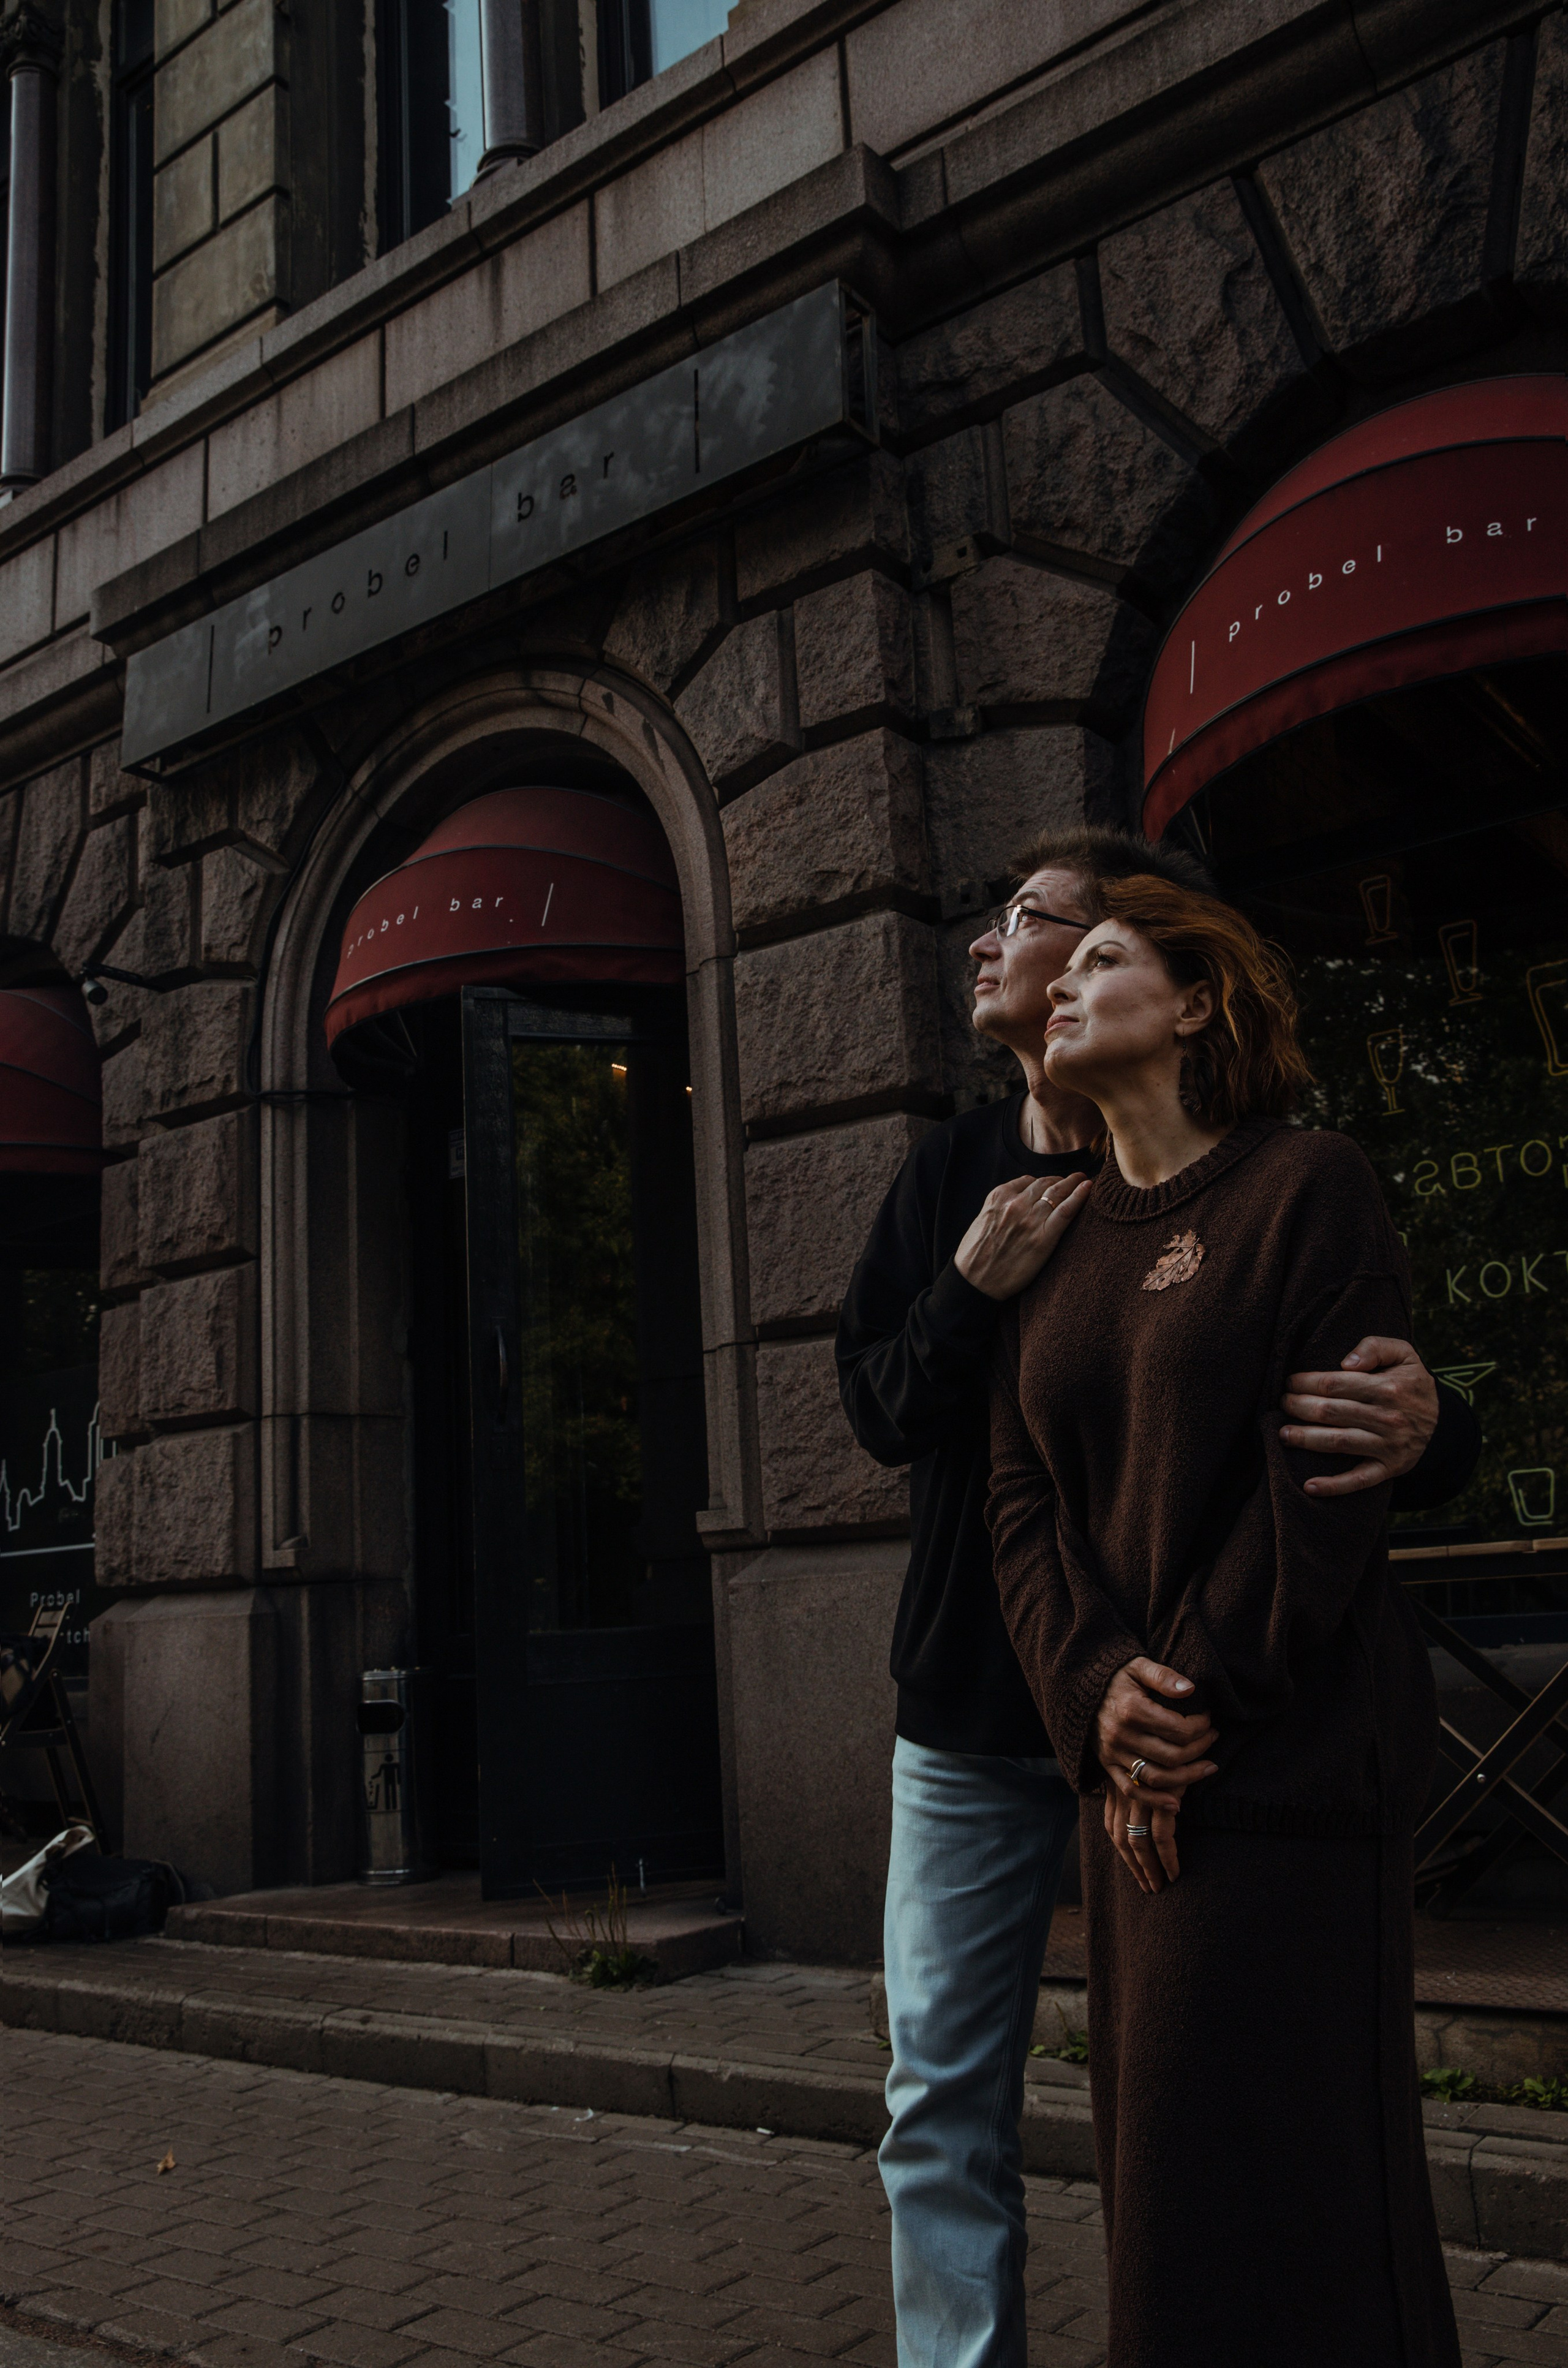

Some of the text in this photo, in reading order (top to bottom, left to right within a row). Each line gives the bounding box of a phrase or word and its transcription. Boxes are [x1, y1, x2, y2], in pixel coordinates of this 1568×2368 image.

[268, 450, 615, 654] probel bar
[1228, 516, 1537, 642] probel bar
[347, 895, 504, 959] probel bar
[29, 1589, 80, 1608] Probel
